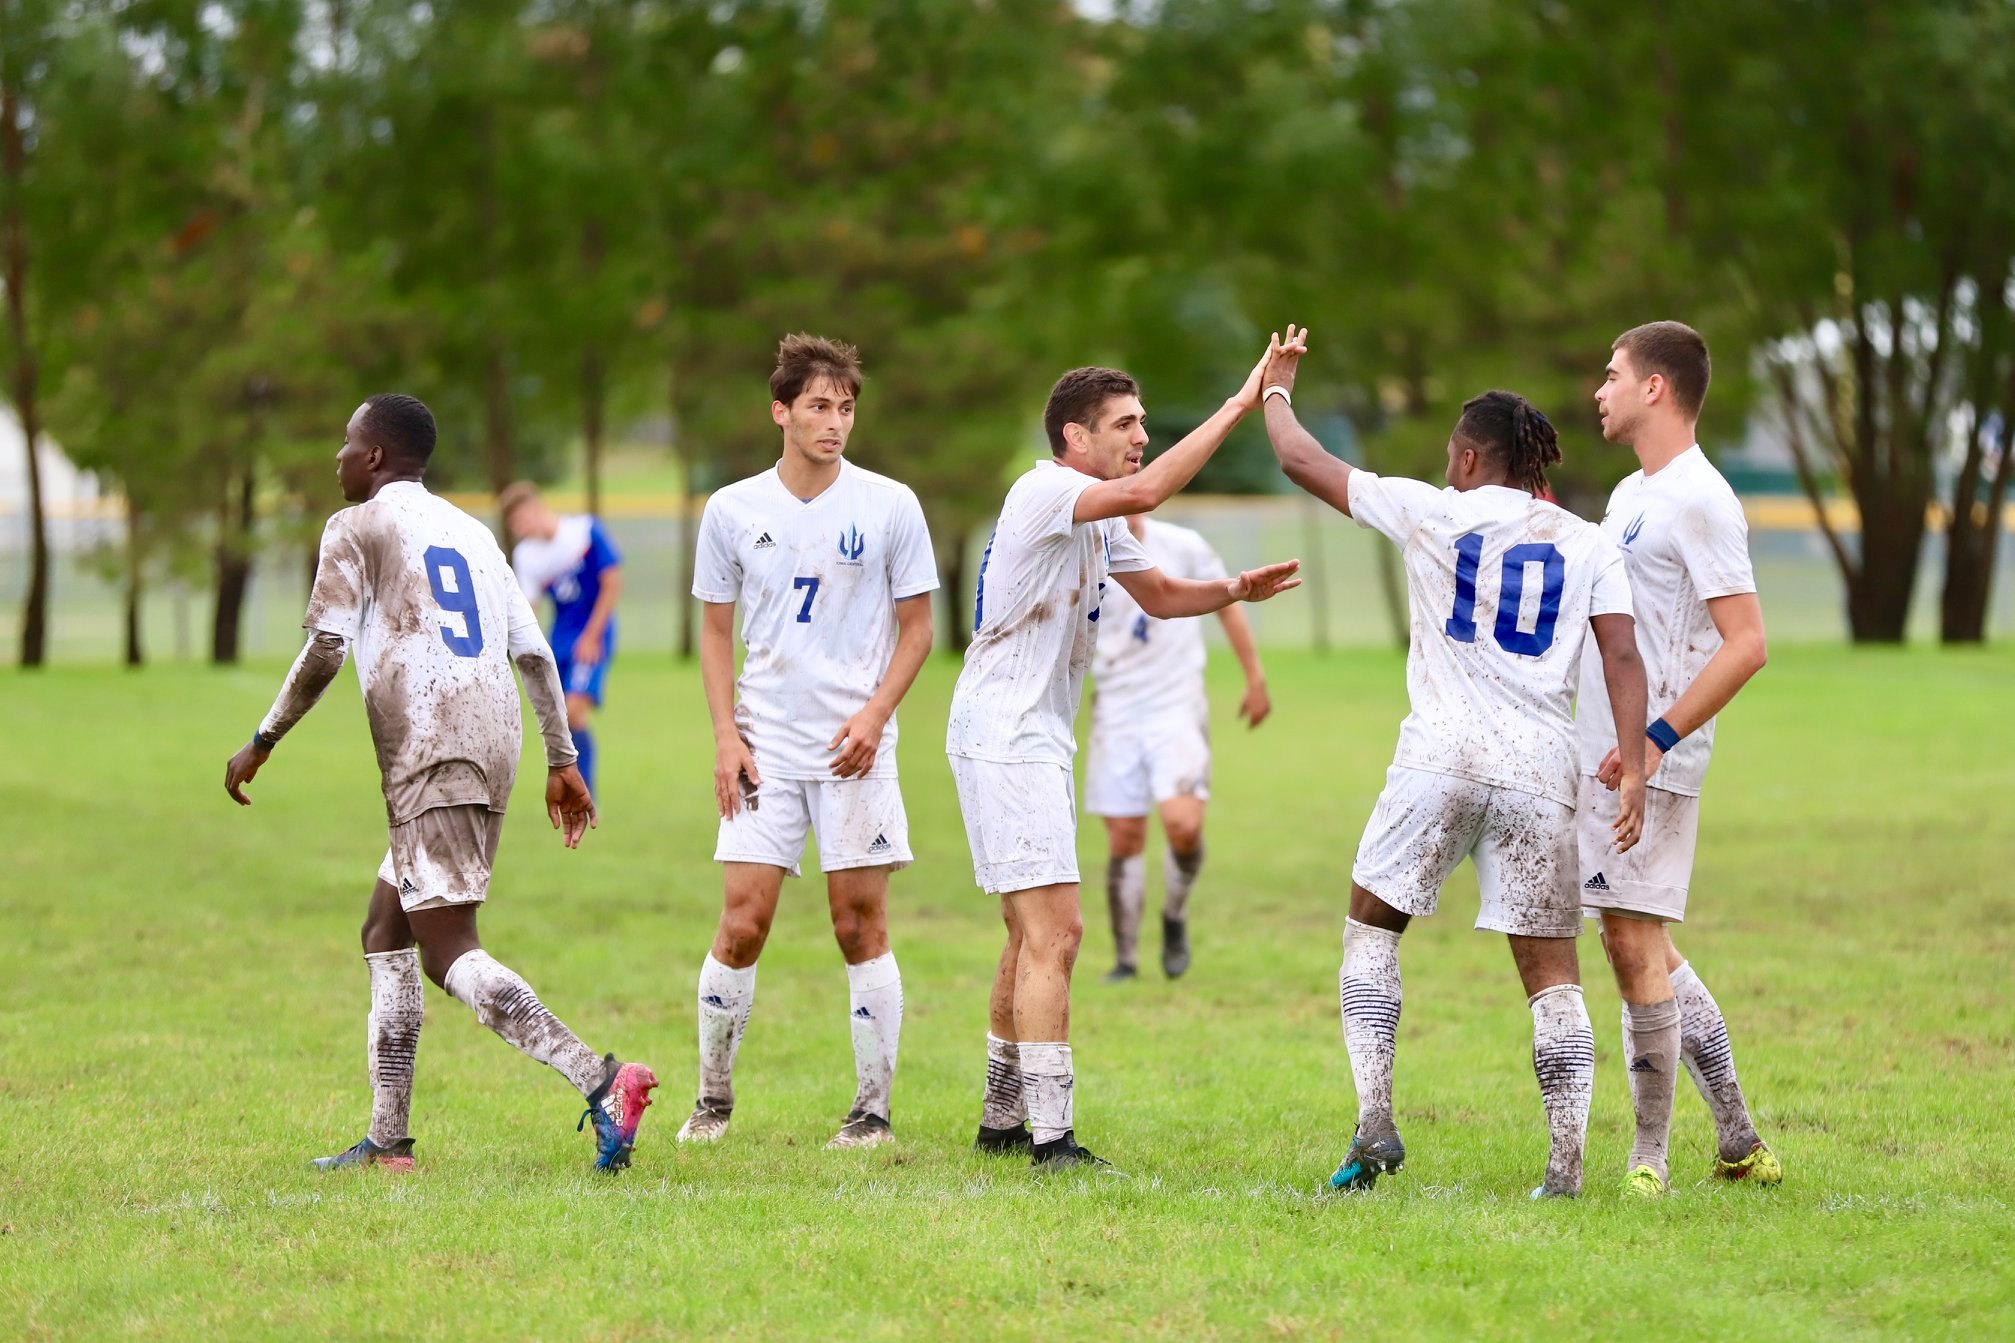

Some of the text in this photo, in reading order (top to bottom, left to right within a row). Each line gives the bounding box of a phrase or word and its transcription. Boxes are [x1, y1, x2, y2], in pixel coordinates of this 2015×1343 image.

[423, 544, 484, 658] 9
[793, 577, 820, 623] 7
[1445, 532, 1565, 657] 10
